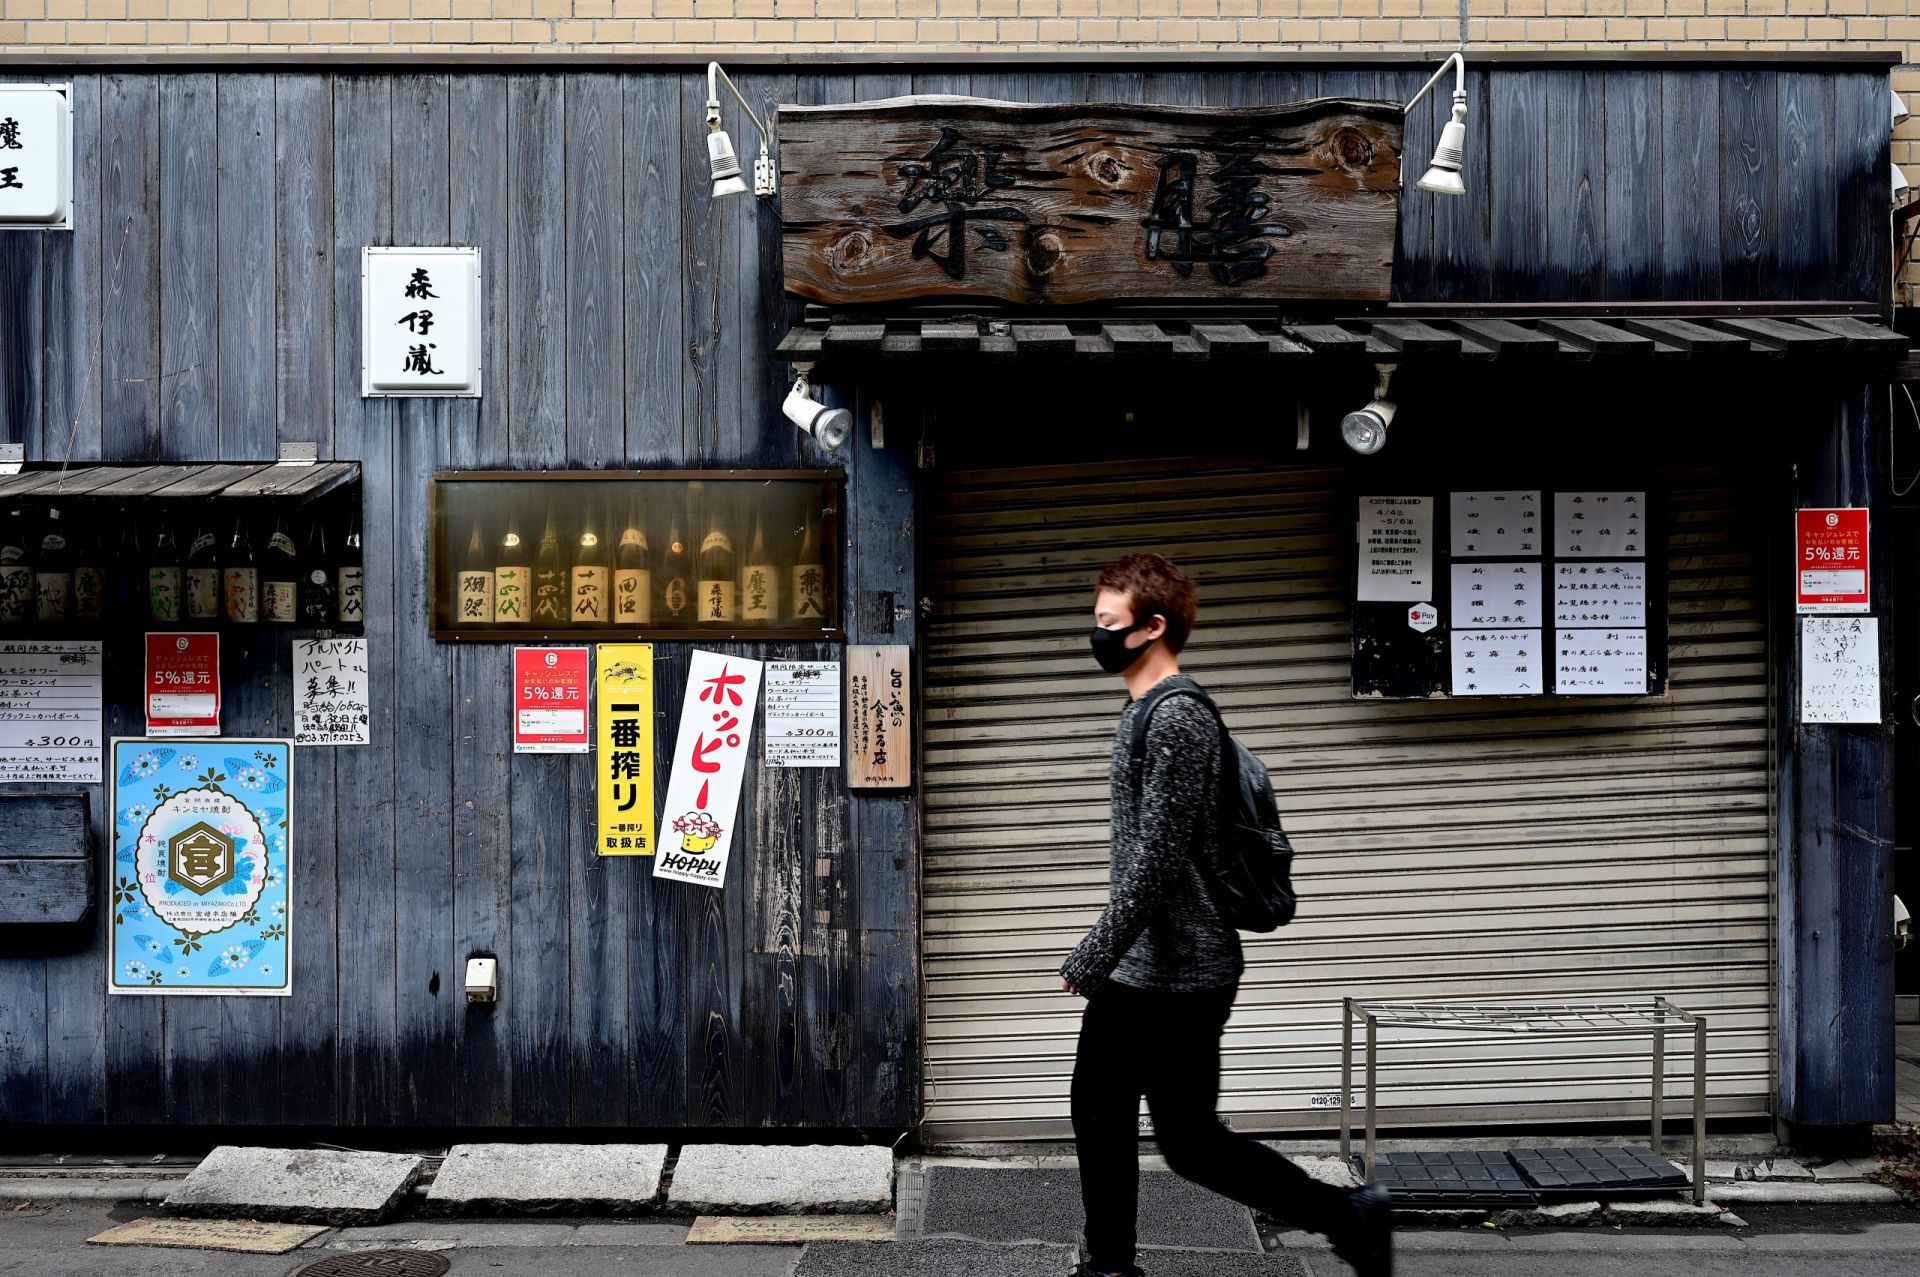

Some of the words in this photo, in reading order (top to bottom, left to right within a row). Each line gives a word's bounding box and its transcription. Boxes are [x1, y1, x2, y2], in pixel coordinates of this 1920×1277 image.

[1805, 546, 1860, 561] 5%還元
[464, 575, 486, 617] 獺祭
[498, 570, 522, 618] 十四代
[536, 570, 558, 619] 十四代
[575, 570, 599, 618] 十四代
[619, 576, 638, 614] 田酒
[747, 570, 768, 611] 魔王
[798, 568, 825, 616] 兼八
[1422, 612, 1435, 620] Pay
[4, 645, 98, 653] 期間限定サービス
[299, 640, 364, 655] アルバイト
[0, 679, 57, 687] ウーロンハイ
[154, 671, 210, 684] 5%還元
[523, 686, 579, 700] 5%還元
[889, 668, 905, 728] 旨い魚の
[25, 736, 93, 746] 各300円
[692, 662, 746, 810] ホッピー
[870, 699, 888, 766] 食える店
[611, 703, 640, 811] 一番搾り
[173, 805, 231, 814] キンミヤ焼酎
[606, 837, 646, 849] 取扱店
[660, 852, 721, 876] Hoppy
